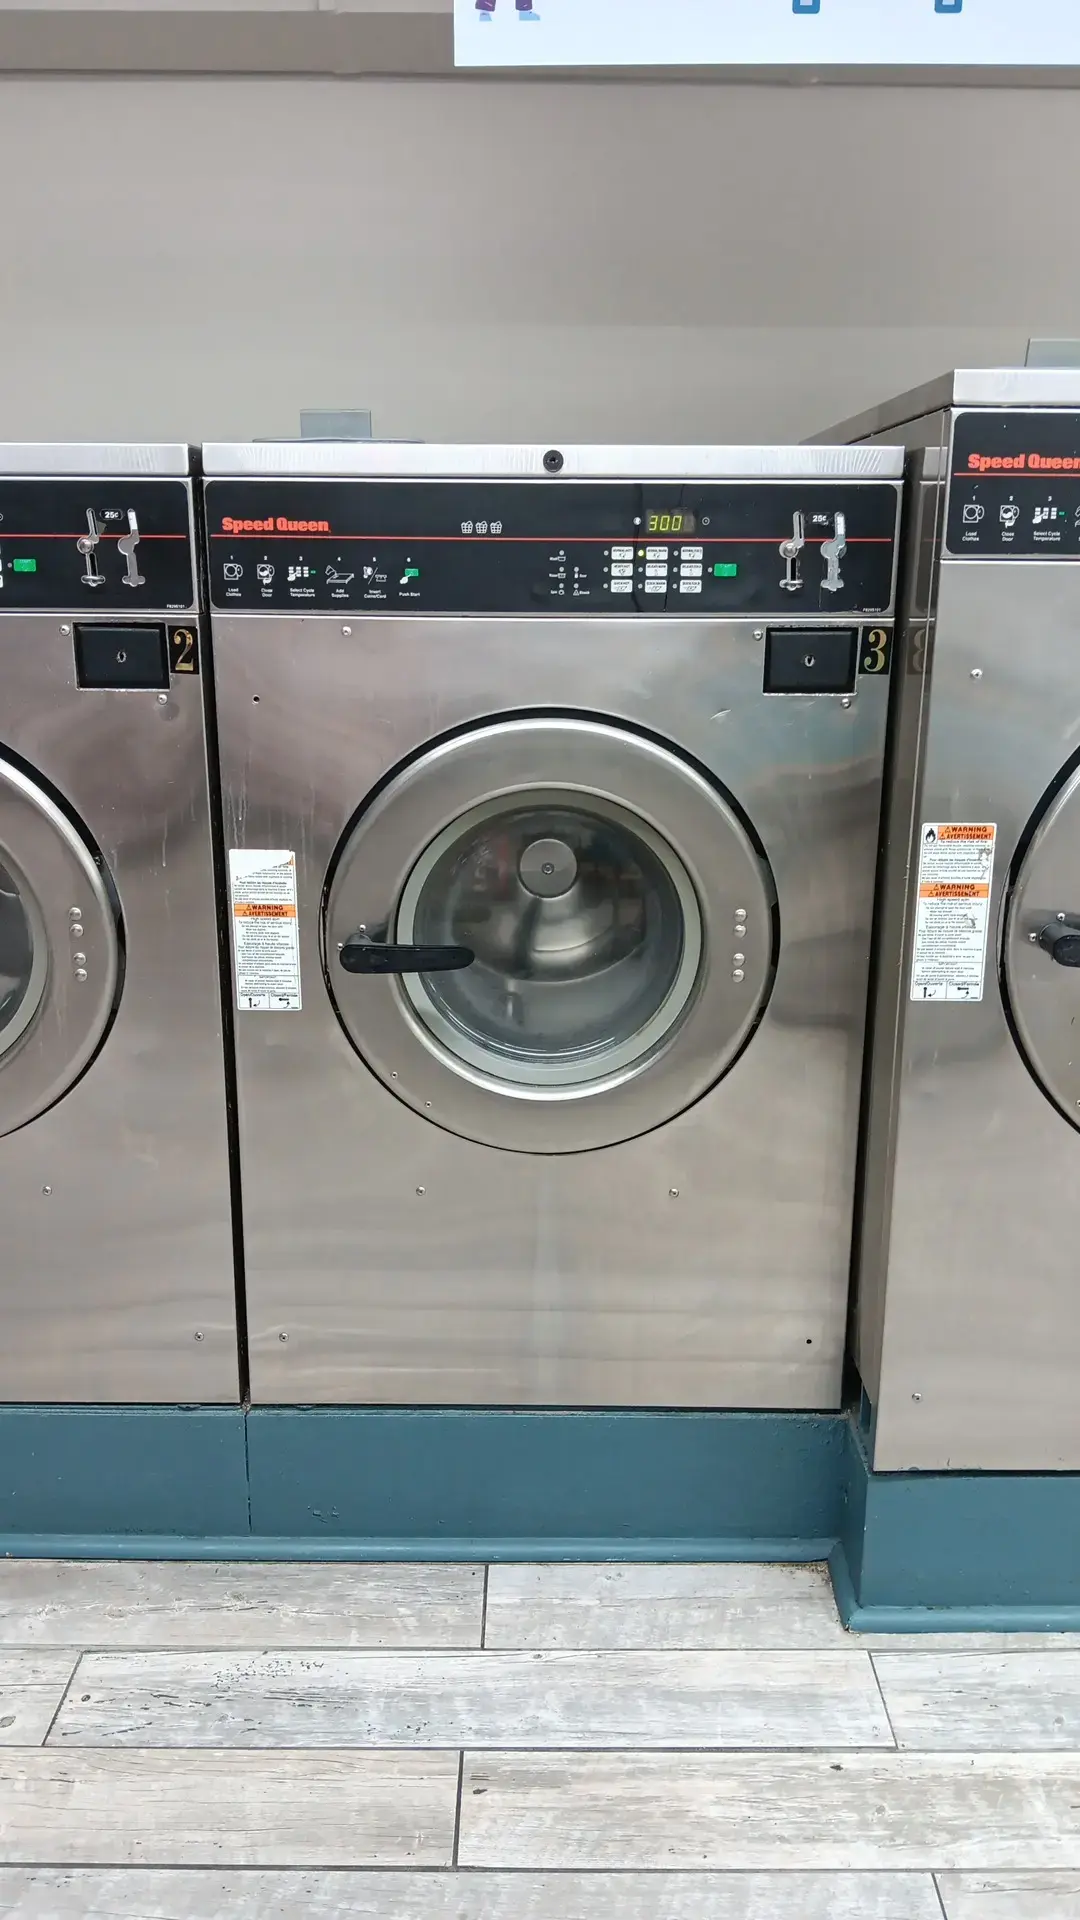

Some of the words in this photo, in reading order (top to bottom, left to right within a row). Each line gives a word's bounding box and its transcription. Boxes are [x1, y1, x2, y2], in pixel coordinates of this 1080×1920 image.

[968, 453, 1026, 471] Speed
[222, 517, 274, 534] Speed
[276, 517, 329, 531] Queen
[649, 515, 682, 531] 300
[173, 628, 194, 671] 2
[864, 629, 888, 672] 3
